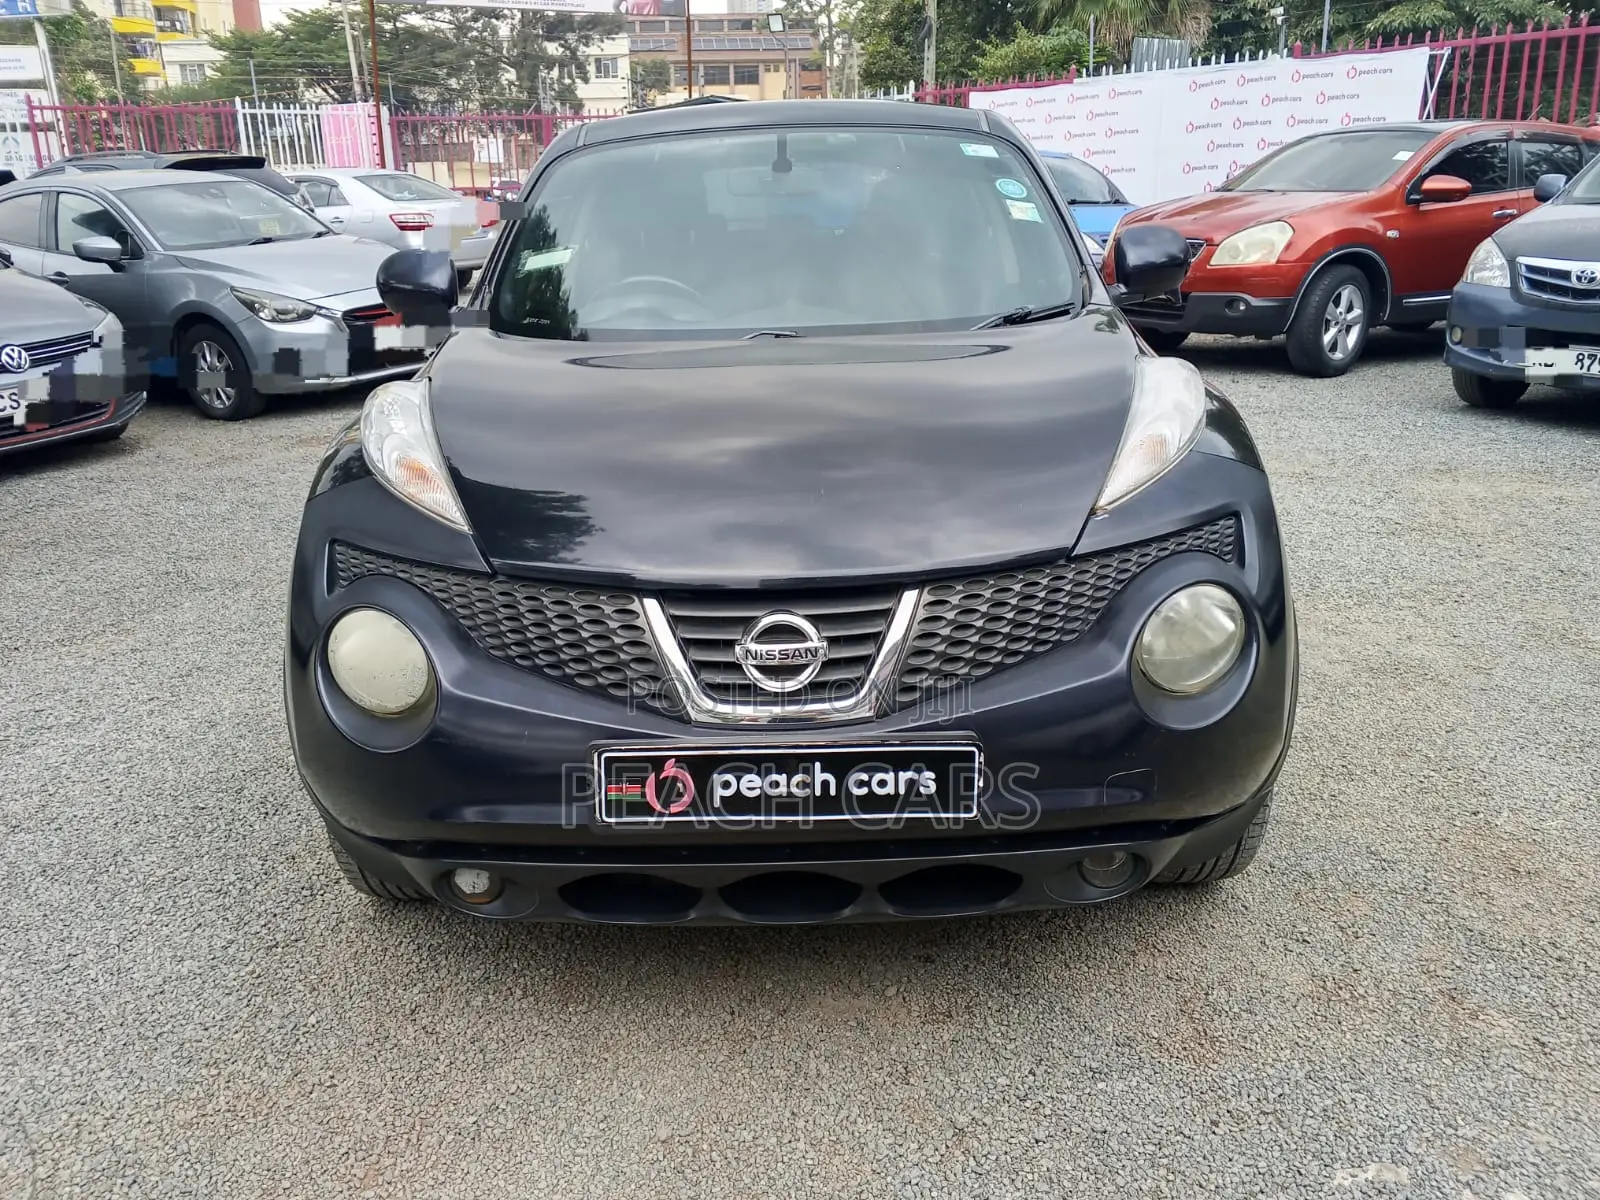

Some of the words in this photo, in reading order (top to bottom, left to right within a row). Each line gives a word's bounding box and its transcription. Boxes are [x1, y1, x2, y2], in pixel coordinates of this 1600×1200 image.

[1302, 71, 1320, 80] peach
[1358, 67, 1377, 77] peach
[1247, 76, 1263, 85] peach
[1199, 81, 1213, 90] peach
[1220, 98, 1235, 107] peach
[1272, 95, 1289, 103] peach
[1327, 94, 1345, 102] peach
[1243, 119, 1259, 128] peach
[1297, 117, 1314, 126] peach
[1352, 115, 1371, 123] peach
[1195, 122, 1210, 131] peach
[1216, 142, 1232, 150] peach
[1192, 163, 1207, 173] peach
[1574, 352, 1600, 374] 87
[745, 647, 818, 661] NISSAN
[713, 761, 836, 807] peach
[848, 769, 937, 796] cars
